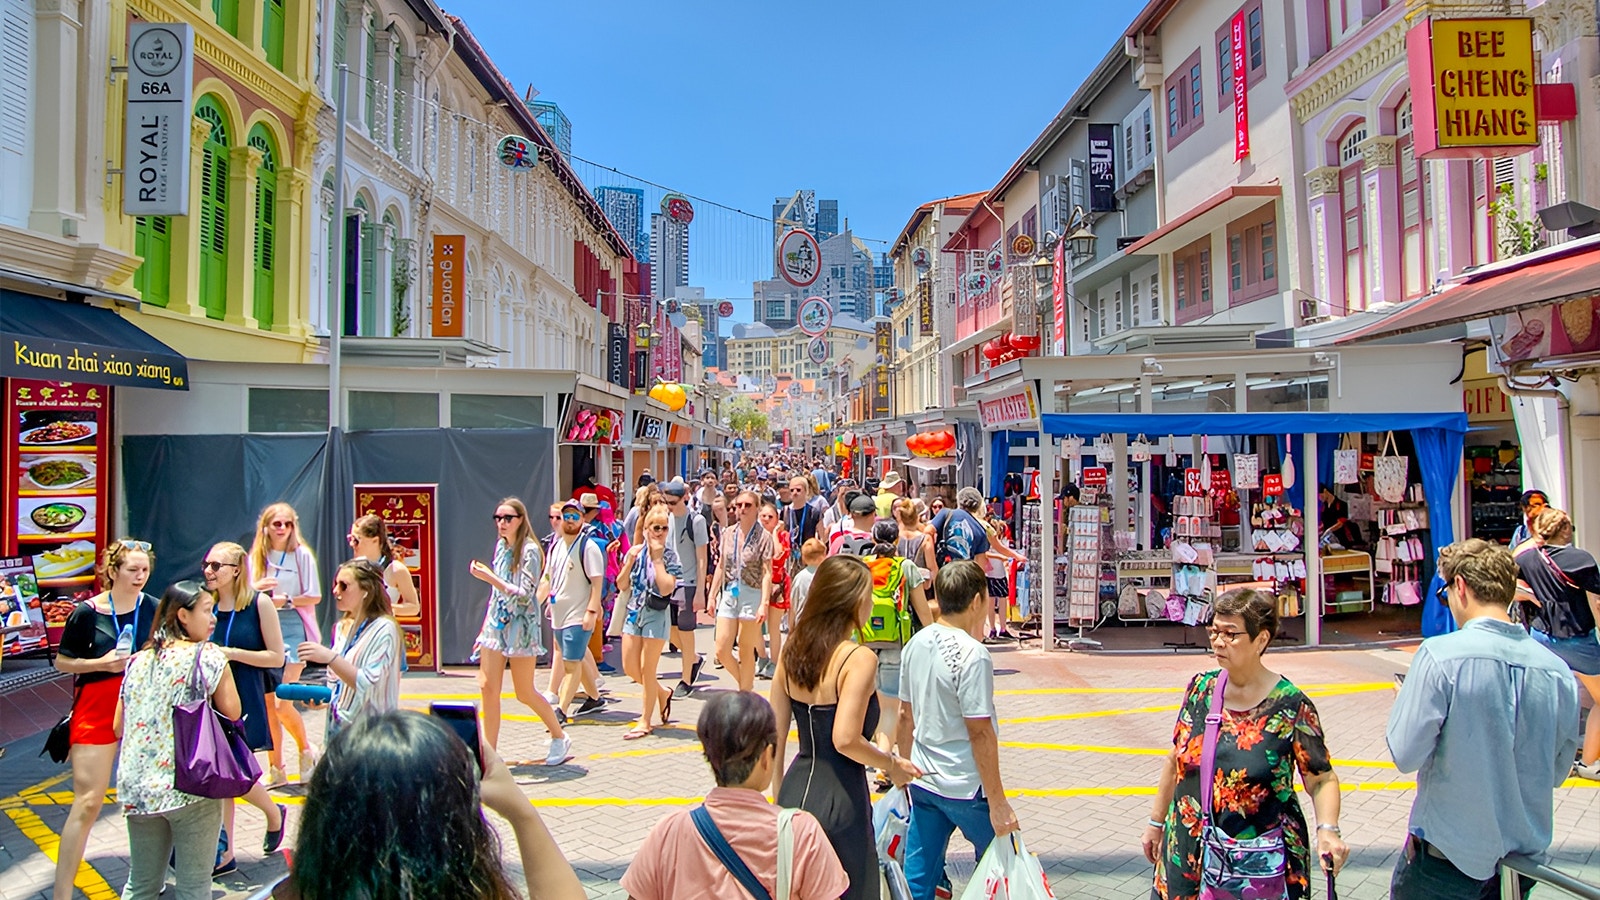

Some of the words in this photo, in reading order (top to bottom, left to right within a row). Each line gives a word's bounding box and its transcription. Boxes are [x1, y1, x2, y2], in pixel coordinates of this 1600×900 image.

[140, 51, 174, 60] ROYAL
[1457, 31, 1505, 58] BEE
[141, 81, 172, 95] 66A
[1440, 69, 1528, 97] CHENG
[1445, 109, 1528, 137] HIANG
[139, 115, 159, 203] ROYAL
[440, 258, 456, 327] guardian
[14, 340, 63, 369] Kuan
[67, 348, 100, 373] zhai
[102, 354, 133, 376] xiao
[136, 358, 171, 384] xiang
